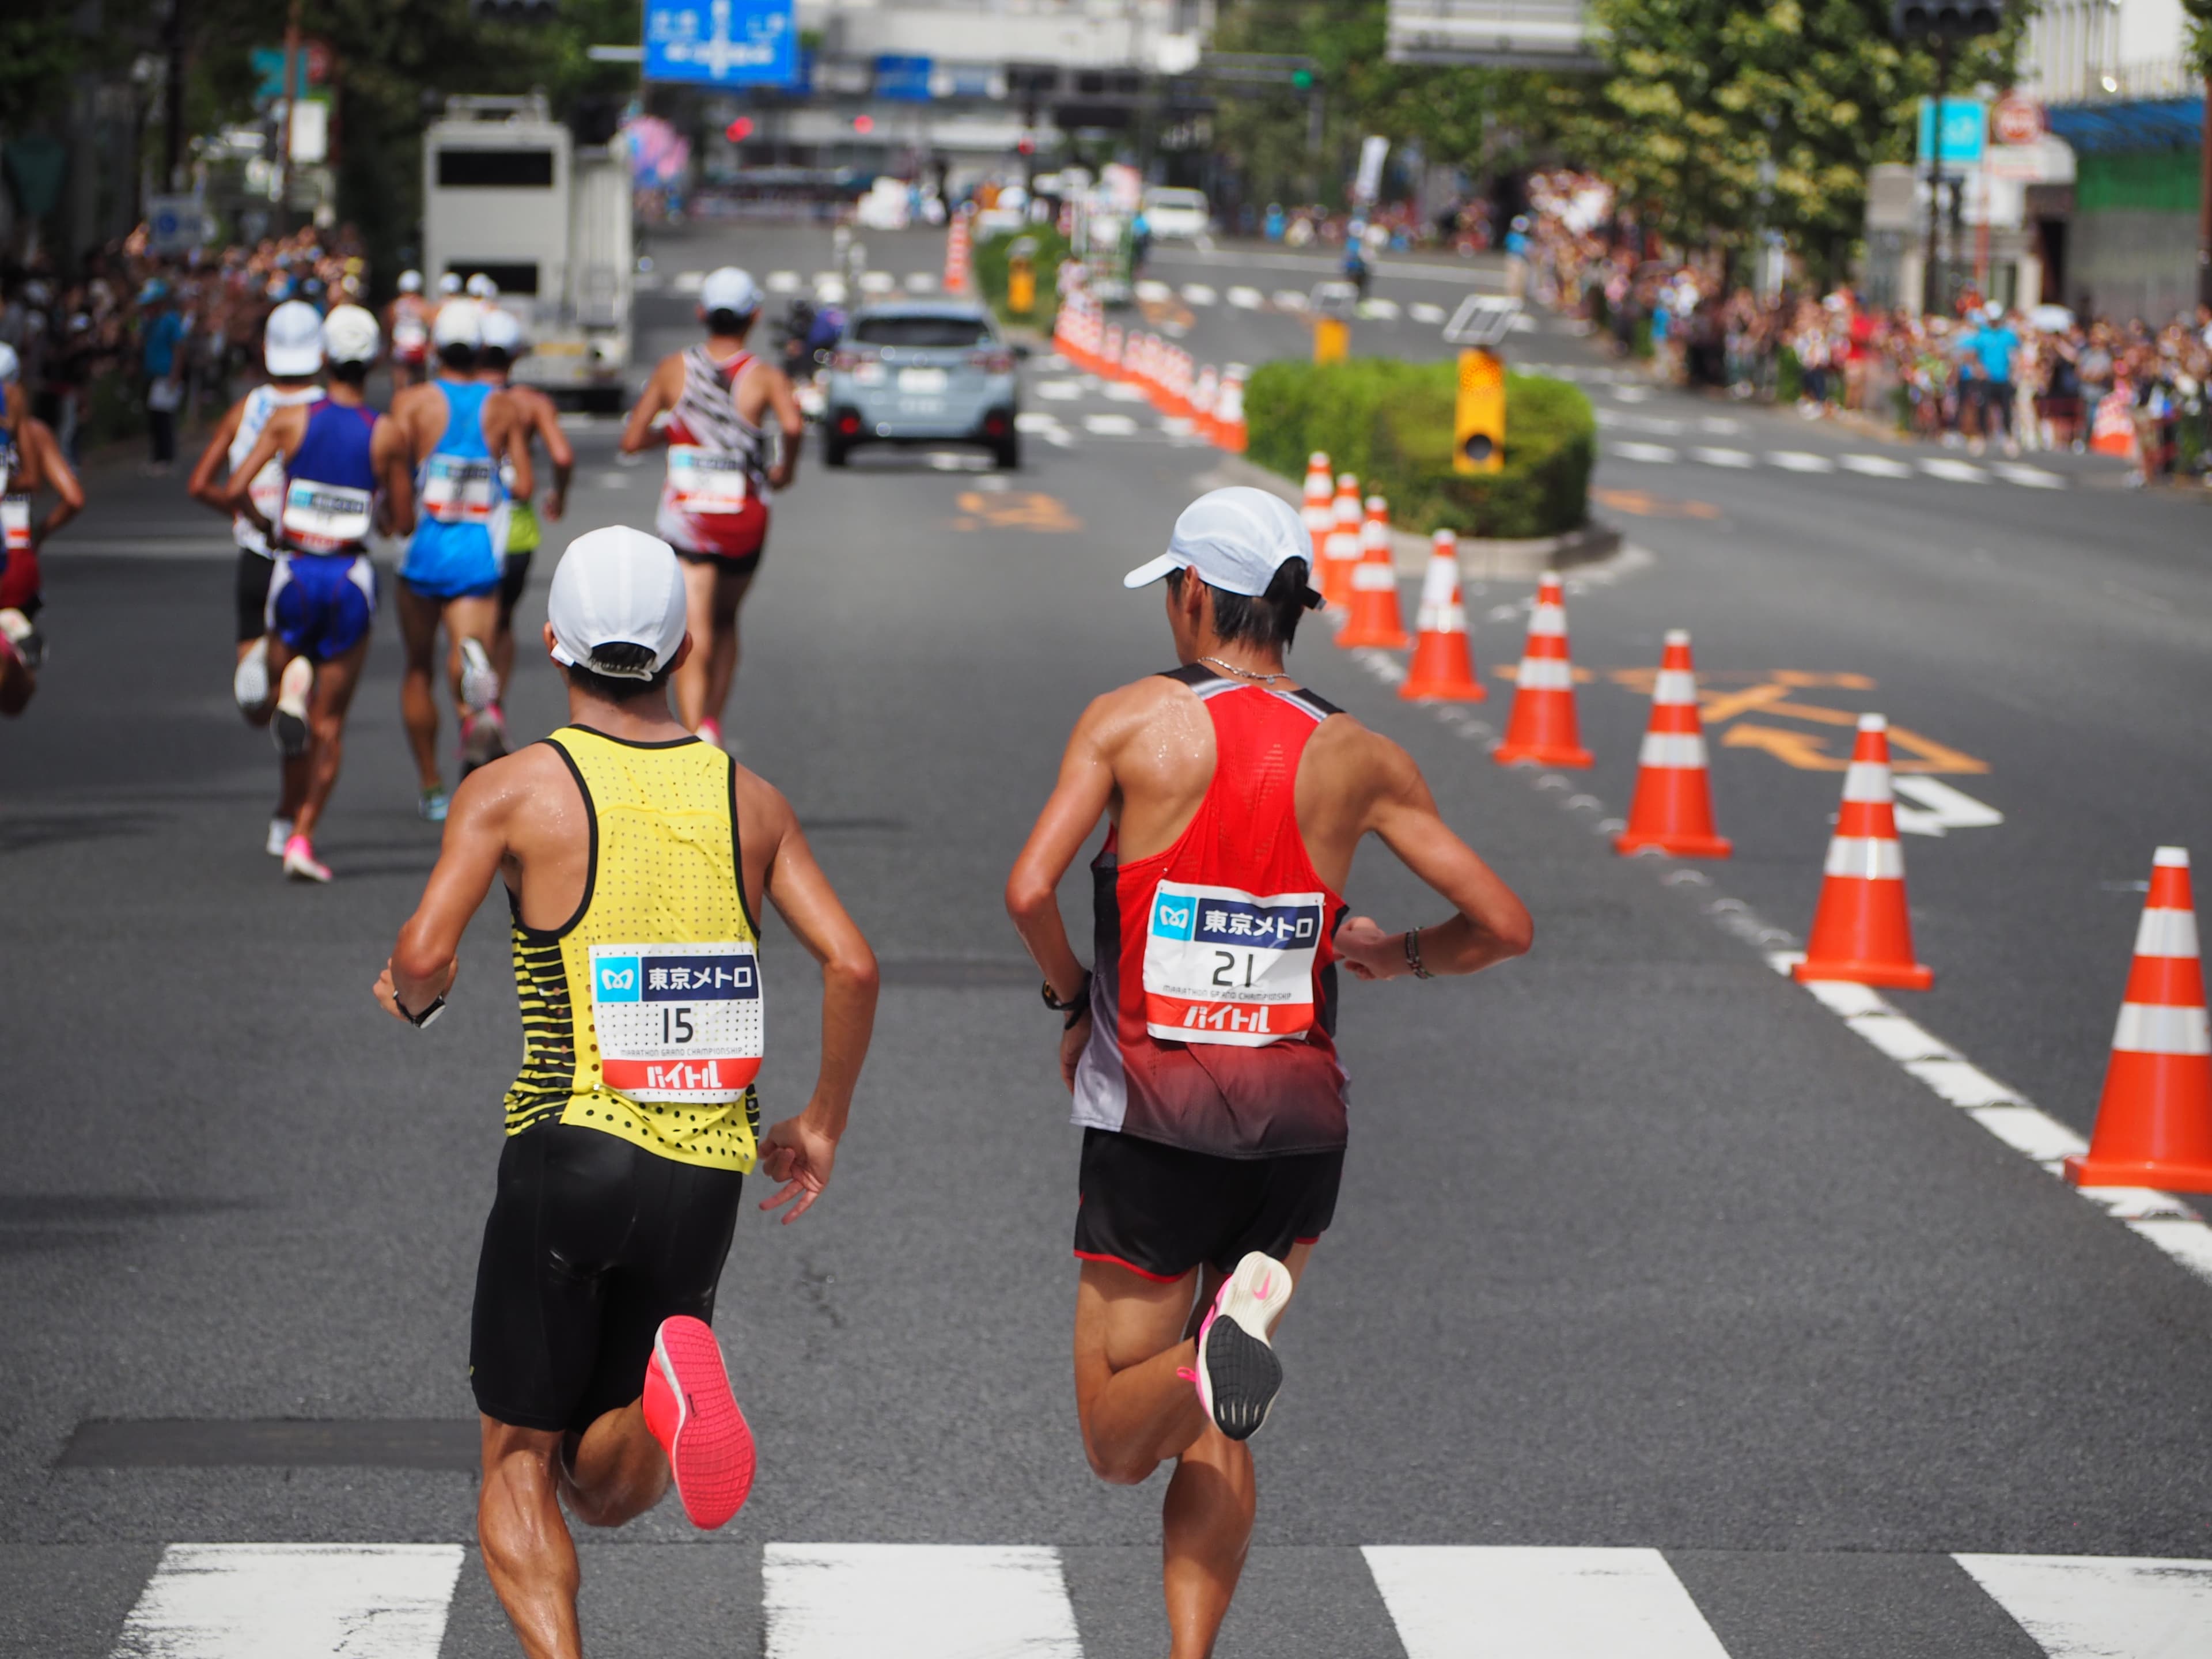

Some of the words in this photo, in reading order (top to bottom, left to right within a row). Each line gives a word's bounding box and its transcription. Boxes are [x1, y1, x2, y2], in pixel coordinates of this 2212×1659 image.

[1203, 910, 1313, 940] 東京メトロ
[648, 967, 752, 990] 東京メトロ
[1213, 951, 1253, 987] 21
[664, 1008, 694, 1043] 15
[1183, 1005, 1271, 1033] バイトル
[687, 1047, 743, 1056] CHAMPIONSHIP
[646, 1060, 722, 1089] バイトル
